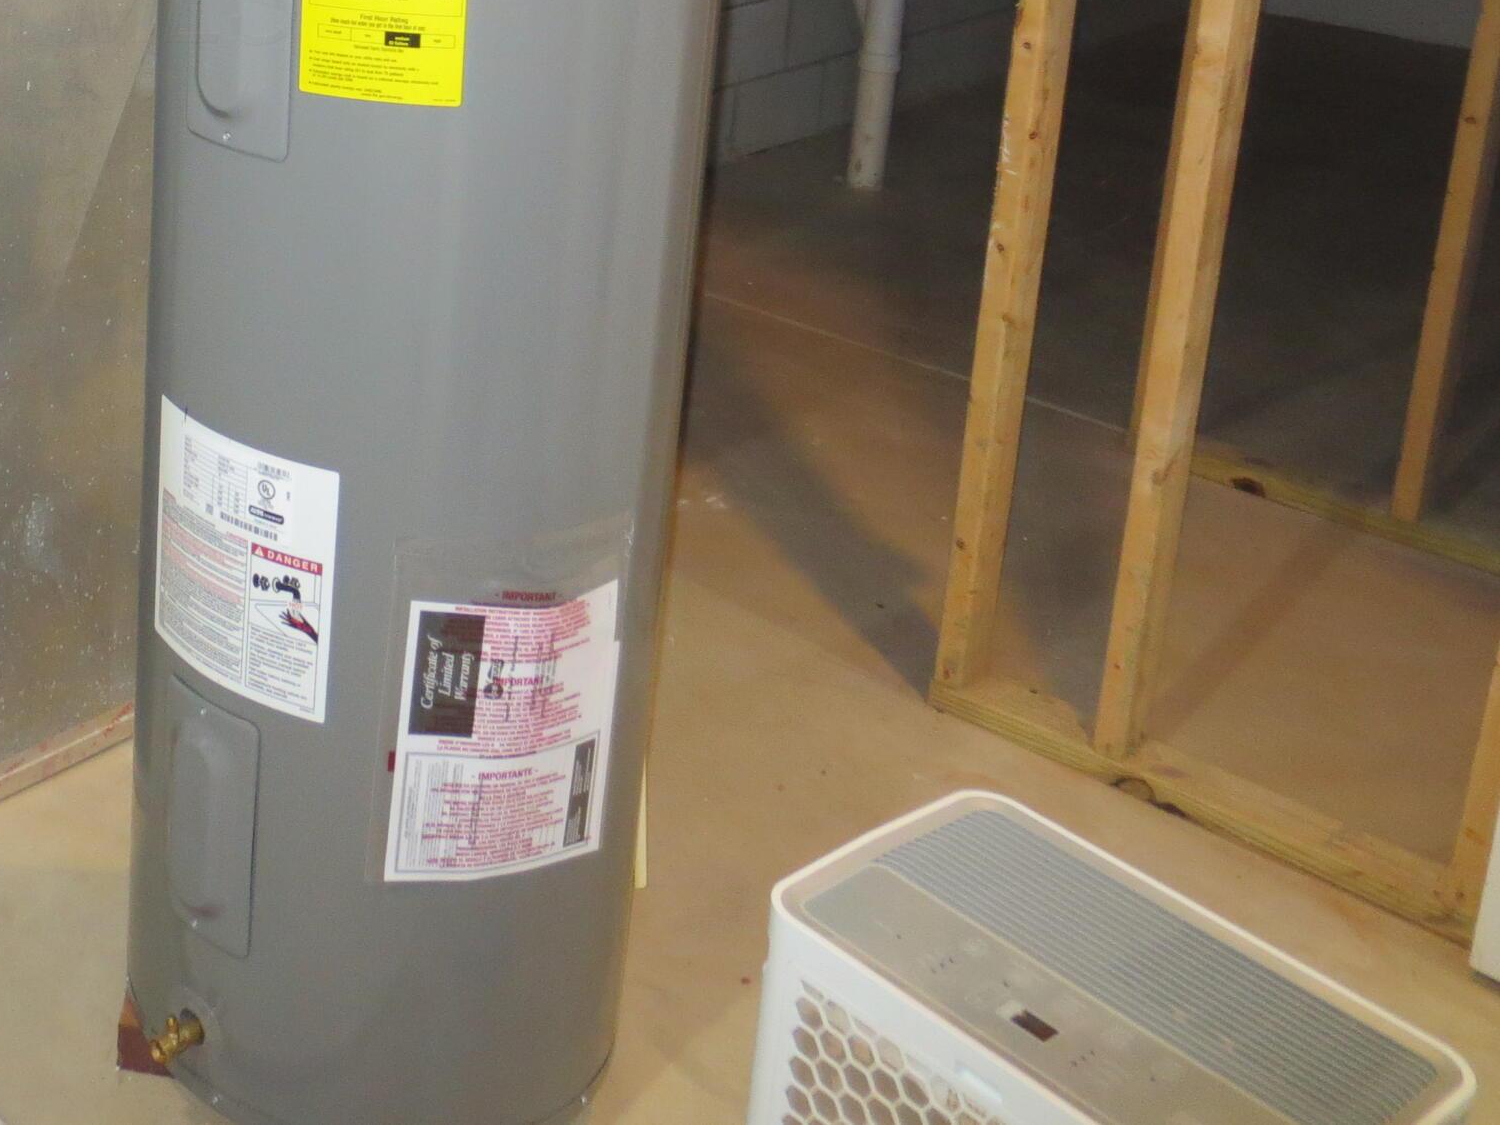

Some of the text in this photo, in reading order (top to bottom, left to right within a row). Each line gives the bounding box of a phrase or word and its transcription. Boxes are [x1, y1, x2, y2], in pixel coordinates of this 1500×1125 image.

[267, 550, 319, 573] DANGER
[502, 591, 557, 602] IMPORTANT
[420, 634, 443, 710] Certificate of
[438, 651, 455, 697] Limited
[454, 651, 475, 701] Warranty
[478, 767, 533, 781] IMPORTANTE
